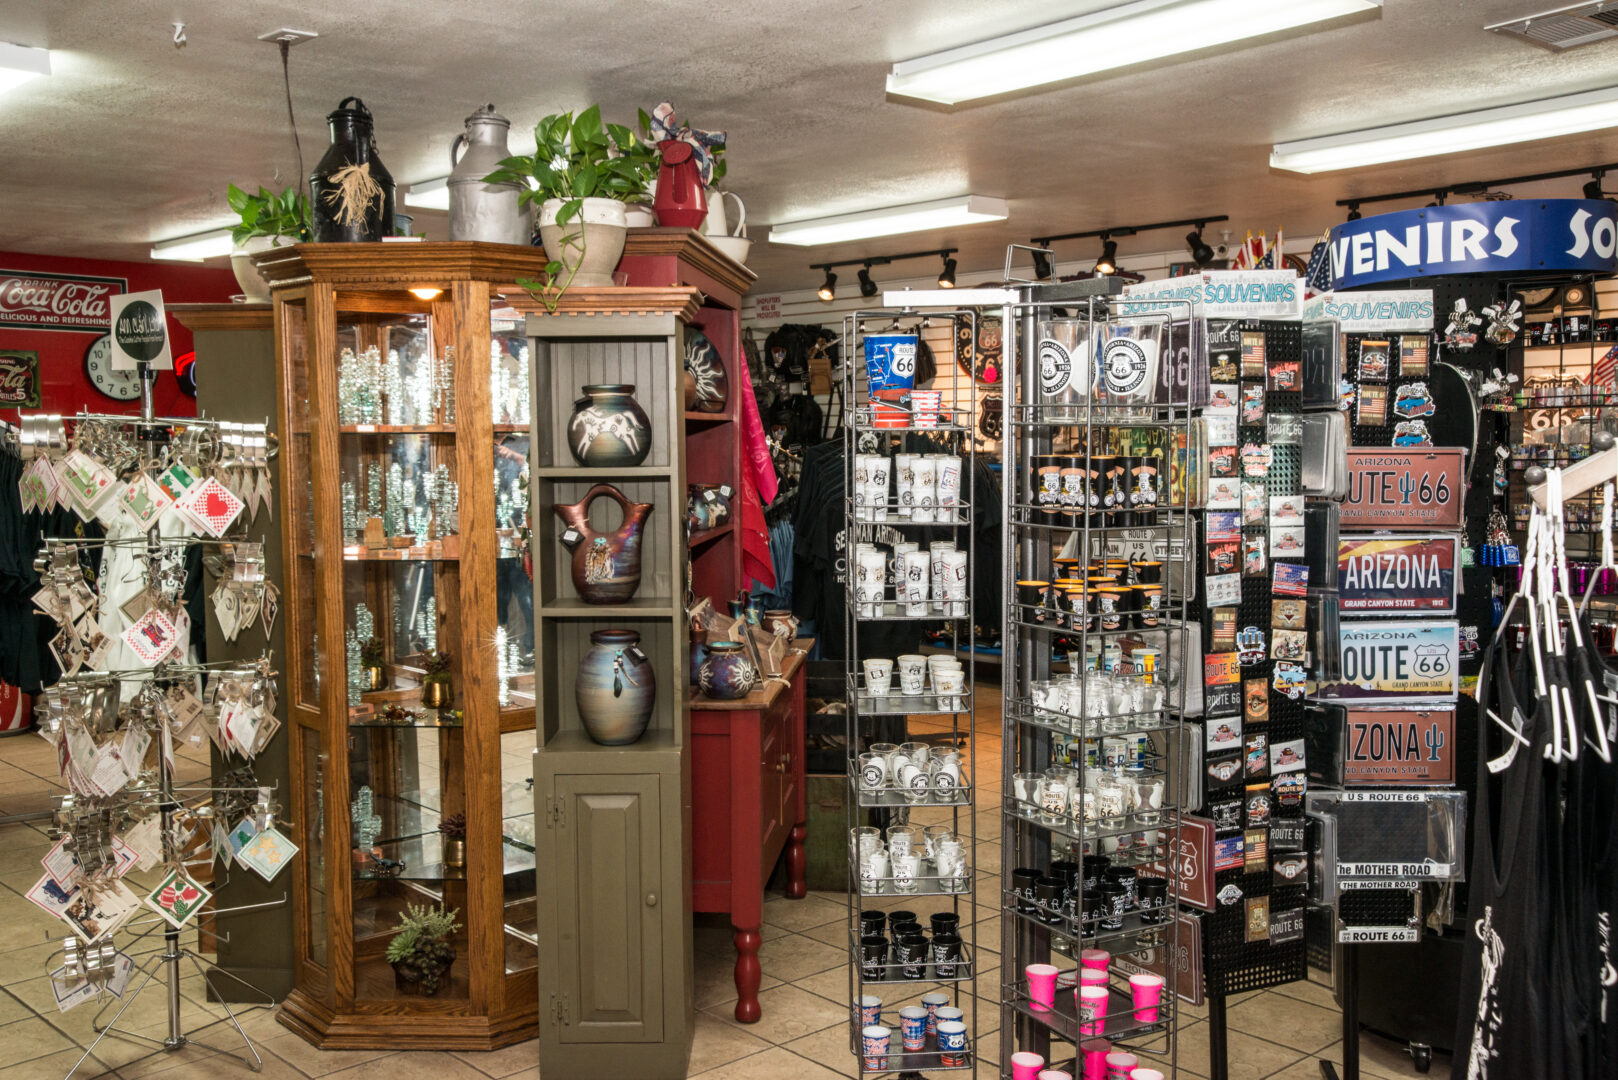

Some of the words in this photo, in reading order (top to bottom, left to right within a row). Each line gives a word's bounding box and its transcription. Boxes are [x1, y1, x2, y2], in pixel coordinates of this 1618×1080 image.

[1330, 216, 1520, 281] VENIRS
[1566, 208, 1618, 259] SO
[24, 279, 59, 288] DRINK
[1204, 283, 1295, 304] SOUVENIRS
[1123, 285, 1202, 315] SOUVENIRS
[1325, 301, 1433, 320] SOUVENIRS
[62, 317, 111, 325] REFRESHING
[1205, 332, 1228, 343] ROUTE
[1230, 331, 1240, 342] 66
[94, 350, 103, 359] 10
[90, 362, 98, 371] 9
[897, 358, 913, 372] 66
[1115, 366, 1127, 374] 66
[96, 375, 104, 384] 8
[107, 383, 115, 393] 7
[120, 387, 128, 396] 6
[132, 384, 140, 392] 5
[17, 388, 26, 400] 5
[1531, 409, 1572, 430] 66
[1268, 424, 1290, 435] ROUTE
[1292, 424, 1302, 434] 66
[1355, 458, 1411, 466] ARIZONA
[1346, 471, 1396, 504] UTE
[1418, 472, 1450, 505] 66
[1367, 508, 1405, 517] CANYON
[1409, 508, 1437, 517] STATE
[1128, 530, 1147, 538] ROUTE
[1344, 554, 1441, 590] ARIZONA
[1343, 632, 1417, 640] ARIZONA
[1466, 631, 1477, 639] 66
[1343, 645, 1409, 681] OUTE
[1420, 657, 1444, 673] 66
[1206, 663, 1228, 677] ROUTE
[1230, 662, 1240, 674] 66
[1206, 693, 1229, 707] ROUTE
[1231, 692, 1240, 704] 66
[1346, 723, 1421, 762] IZONA
[1369, 793, 1404, 801] ROUTE
[1405, 793, 1420, 801] 66
[1046, 804, 1061, 814] 66
[1270, 829, 1292, 840] ROUTE
[1294, 829, 1304, 840] 66
[1173, 857, 1194, 876] 66
[1337, 865, 1351, 875] The
[1355, 865, 1398, 875] MOTHER
[1402, 865, 1431, 875] ROAD
[1270, 920, 1292, 935] ROUTE
[1294, 919, 1303, 929] 66
[1353, 932, 1388, 940] ROUTE
[1391, 931, 1405, 940] 66
